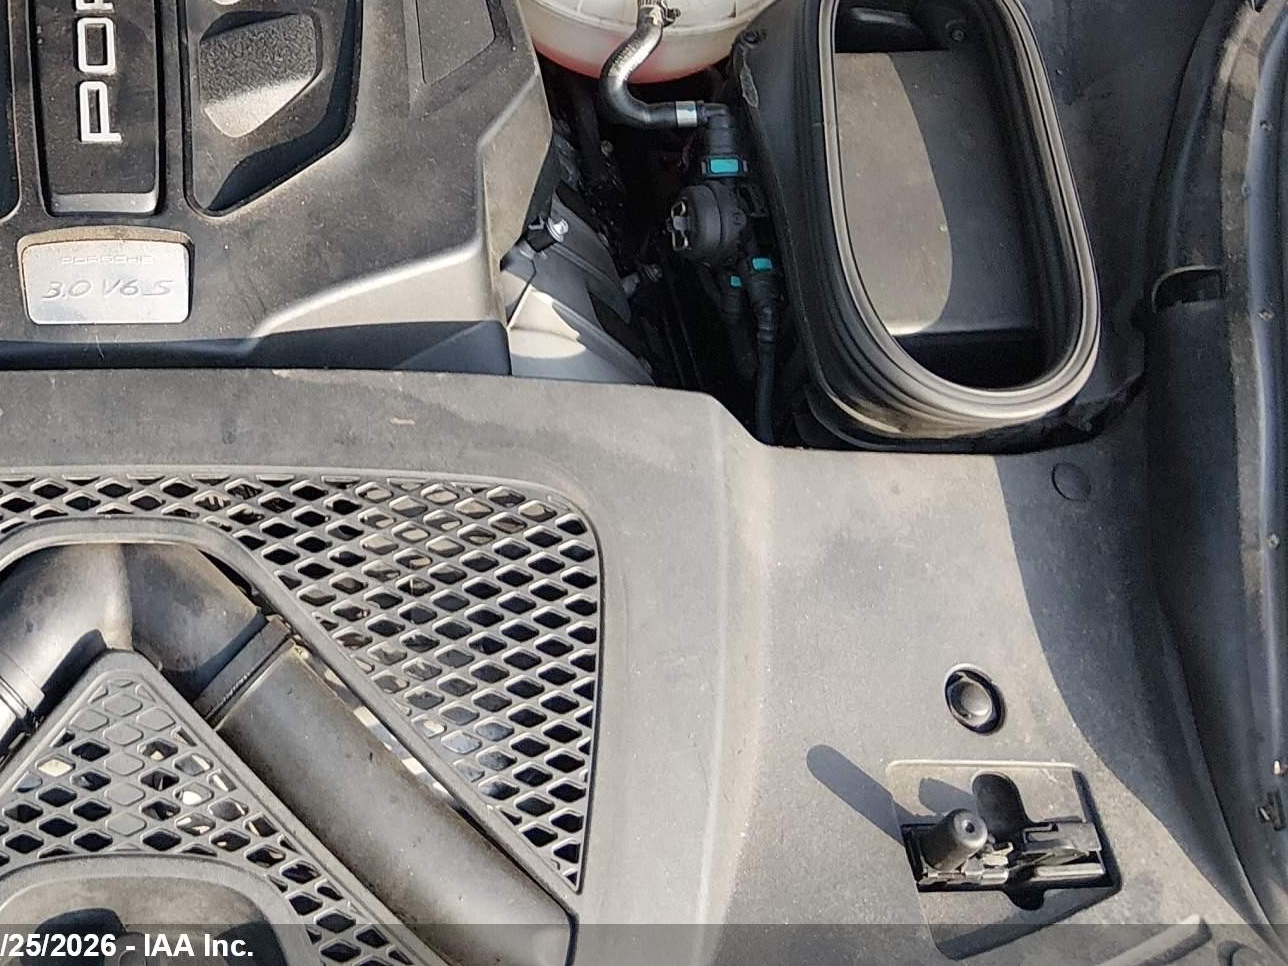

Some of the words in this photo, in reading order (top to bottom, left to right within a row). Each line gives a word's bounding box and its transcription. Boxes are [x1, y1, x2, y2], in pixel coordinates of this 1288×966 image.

[60, 255, 153, 265] PORSCHE
[42, 280, 92, 300] 3.0
[102, 279, 139, 298] V6
